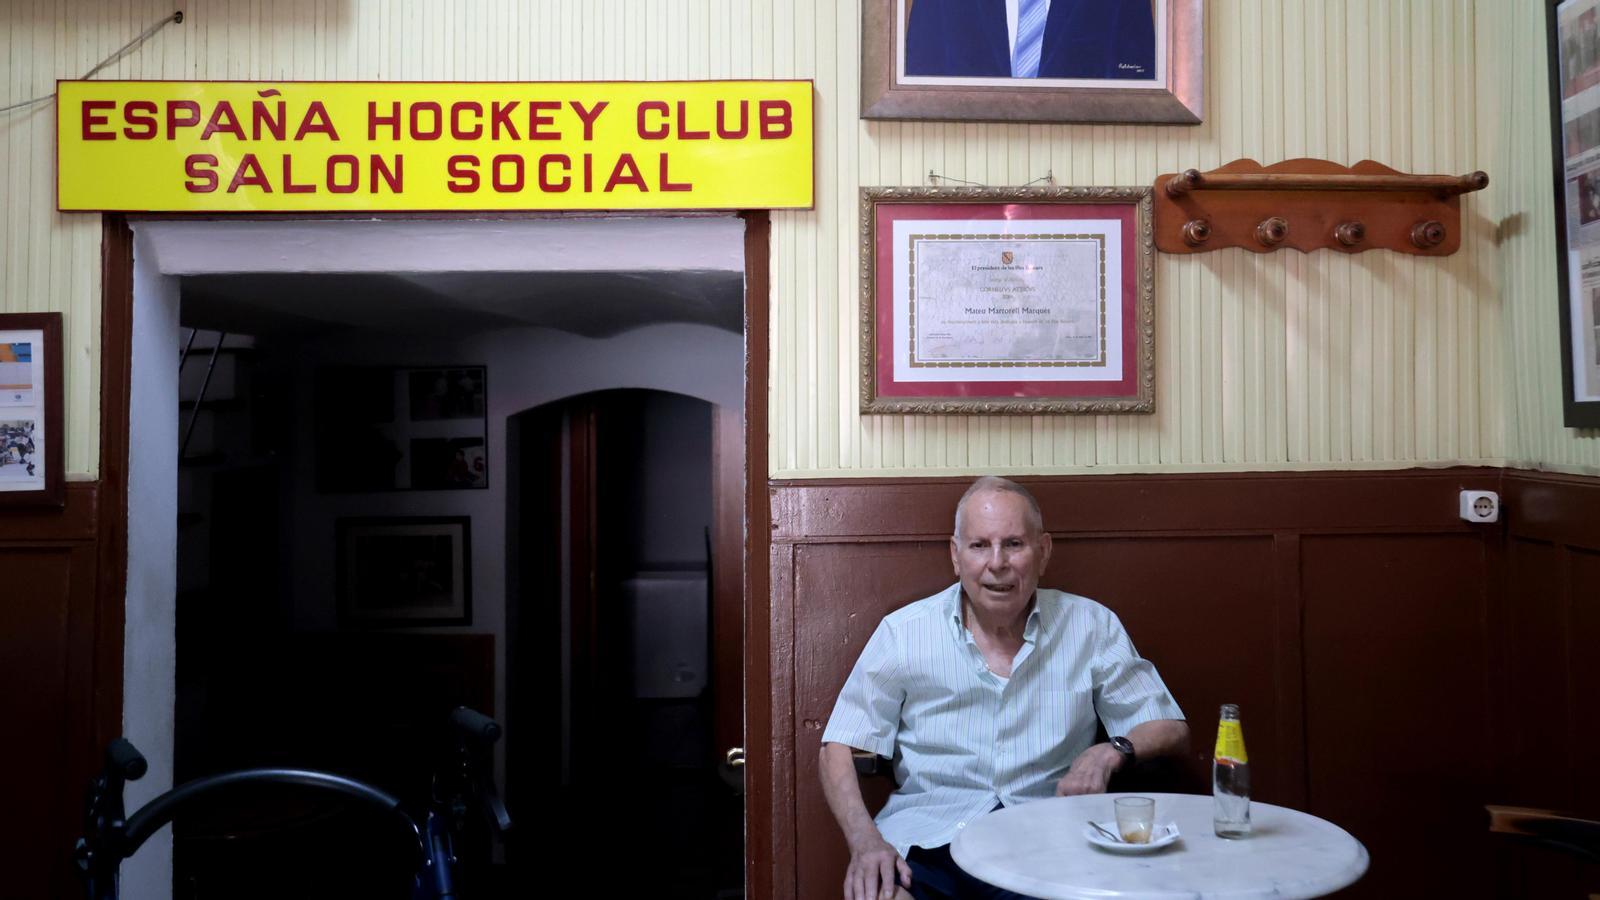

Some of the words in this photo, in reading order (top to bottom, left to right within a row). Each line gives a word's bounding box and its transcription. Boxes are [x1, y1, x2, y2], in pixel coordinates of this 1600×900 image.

[82, 89, 340, 141] ESPAÑA
[367, 101, 609, 141] HOCKEY
[636, 100, 793, 140] CLUB
[184, 153, 404, 194] SALON
[447, 153, 693, 193] SOCIAL
